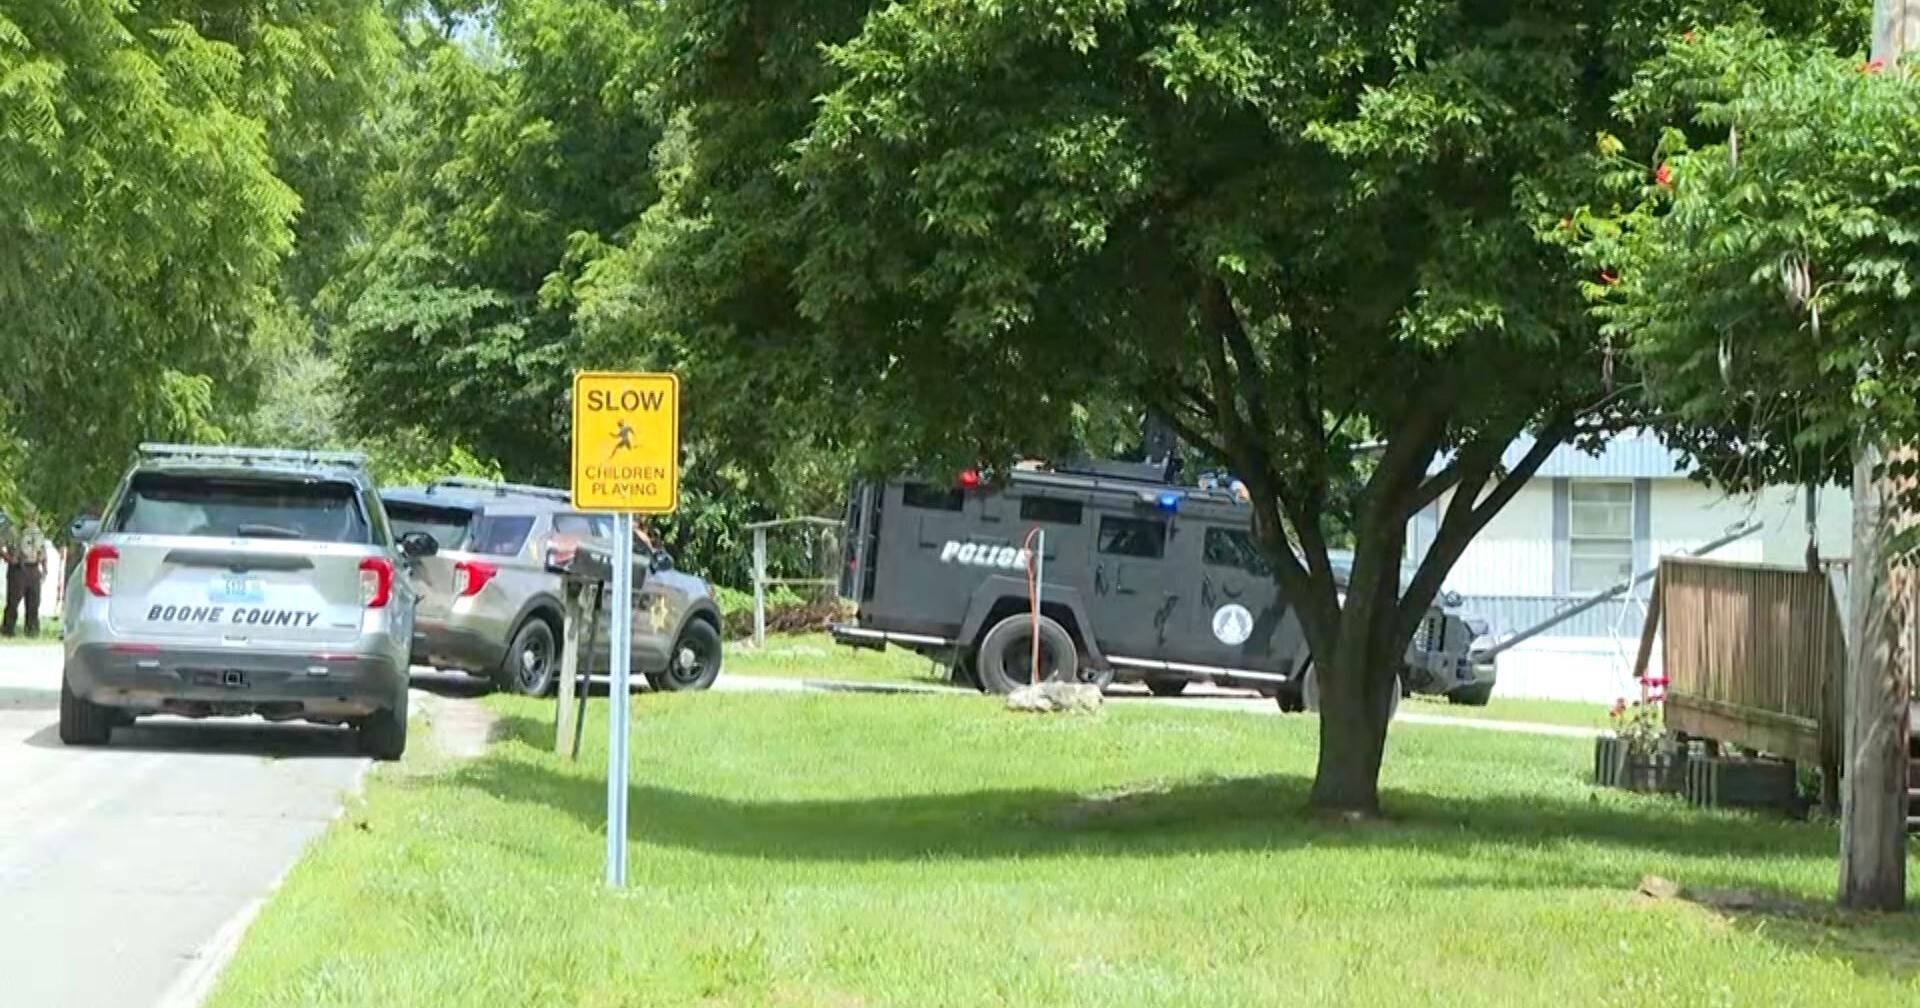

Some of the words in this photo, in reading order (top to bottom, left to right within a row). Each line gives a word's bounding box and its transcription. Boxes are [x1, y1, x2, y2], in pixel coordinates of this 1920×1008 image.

[587, 390, 664, 412] SLOW
[585, 466, 665, 480] CHILDREN
[592, 482, 657, 496] PLAYING
[147, 604, 224, 623] BOONE
[232, 607, 320, 627] COUNTY
